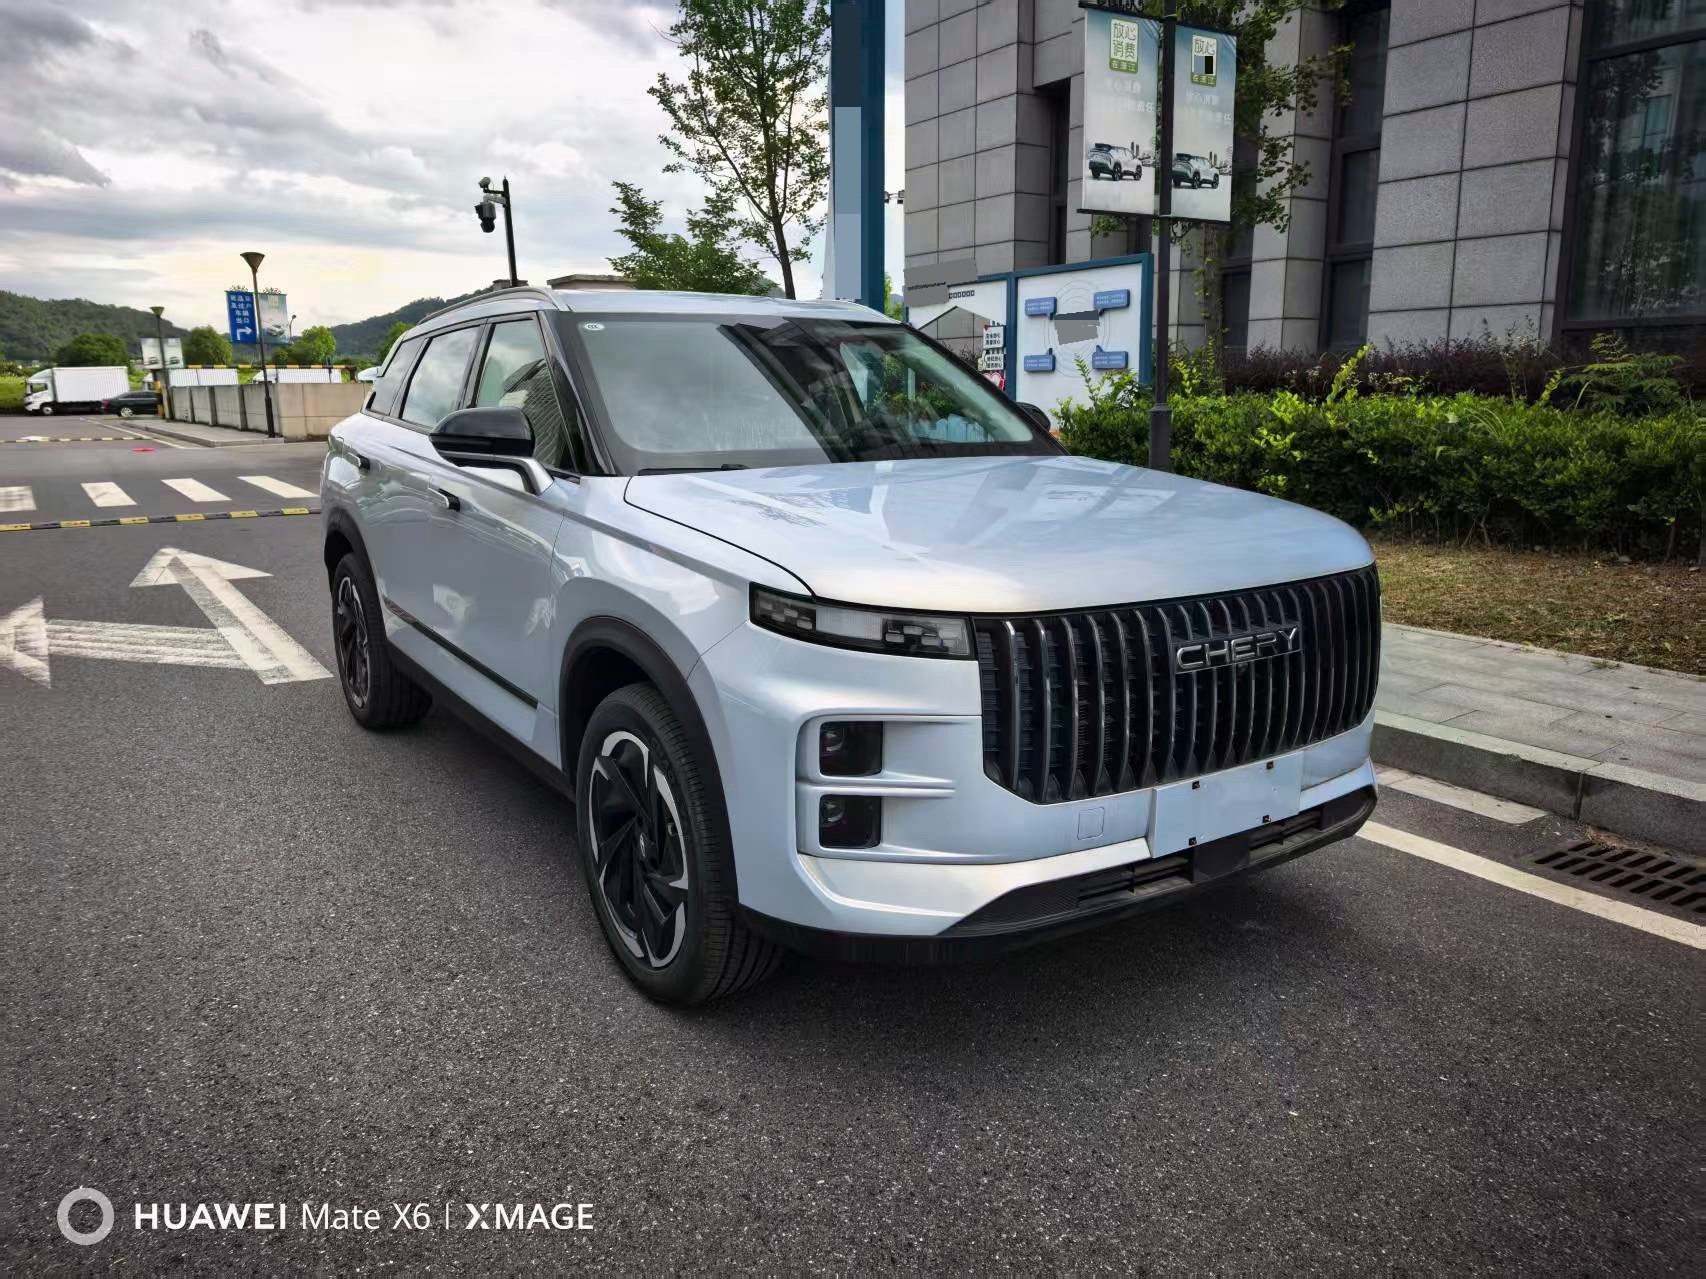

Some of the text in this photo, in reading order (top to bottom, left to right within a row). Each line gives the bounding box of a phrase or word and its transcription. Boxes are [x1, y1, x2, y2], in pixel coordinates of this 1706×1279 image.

[1112, 22, 1136, 41] 放心
[1112, 39, 1136, 59] 消费
[1194, 37, 1216, 56] 放心
